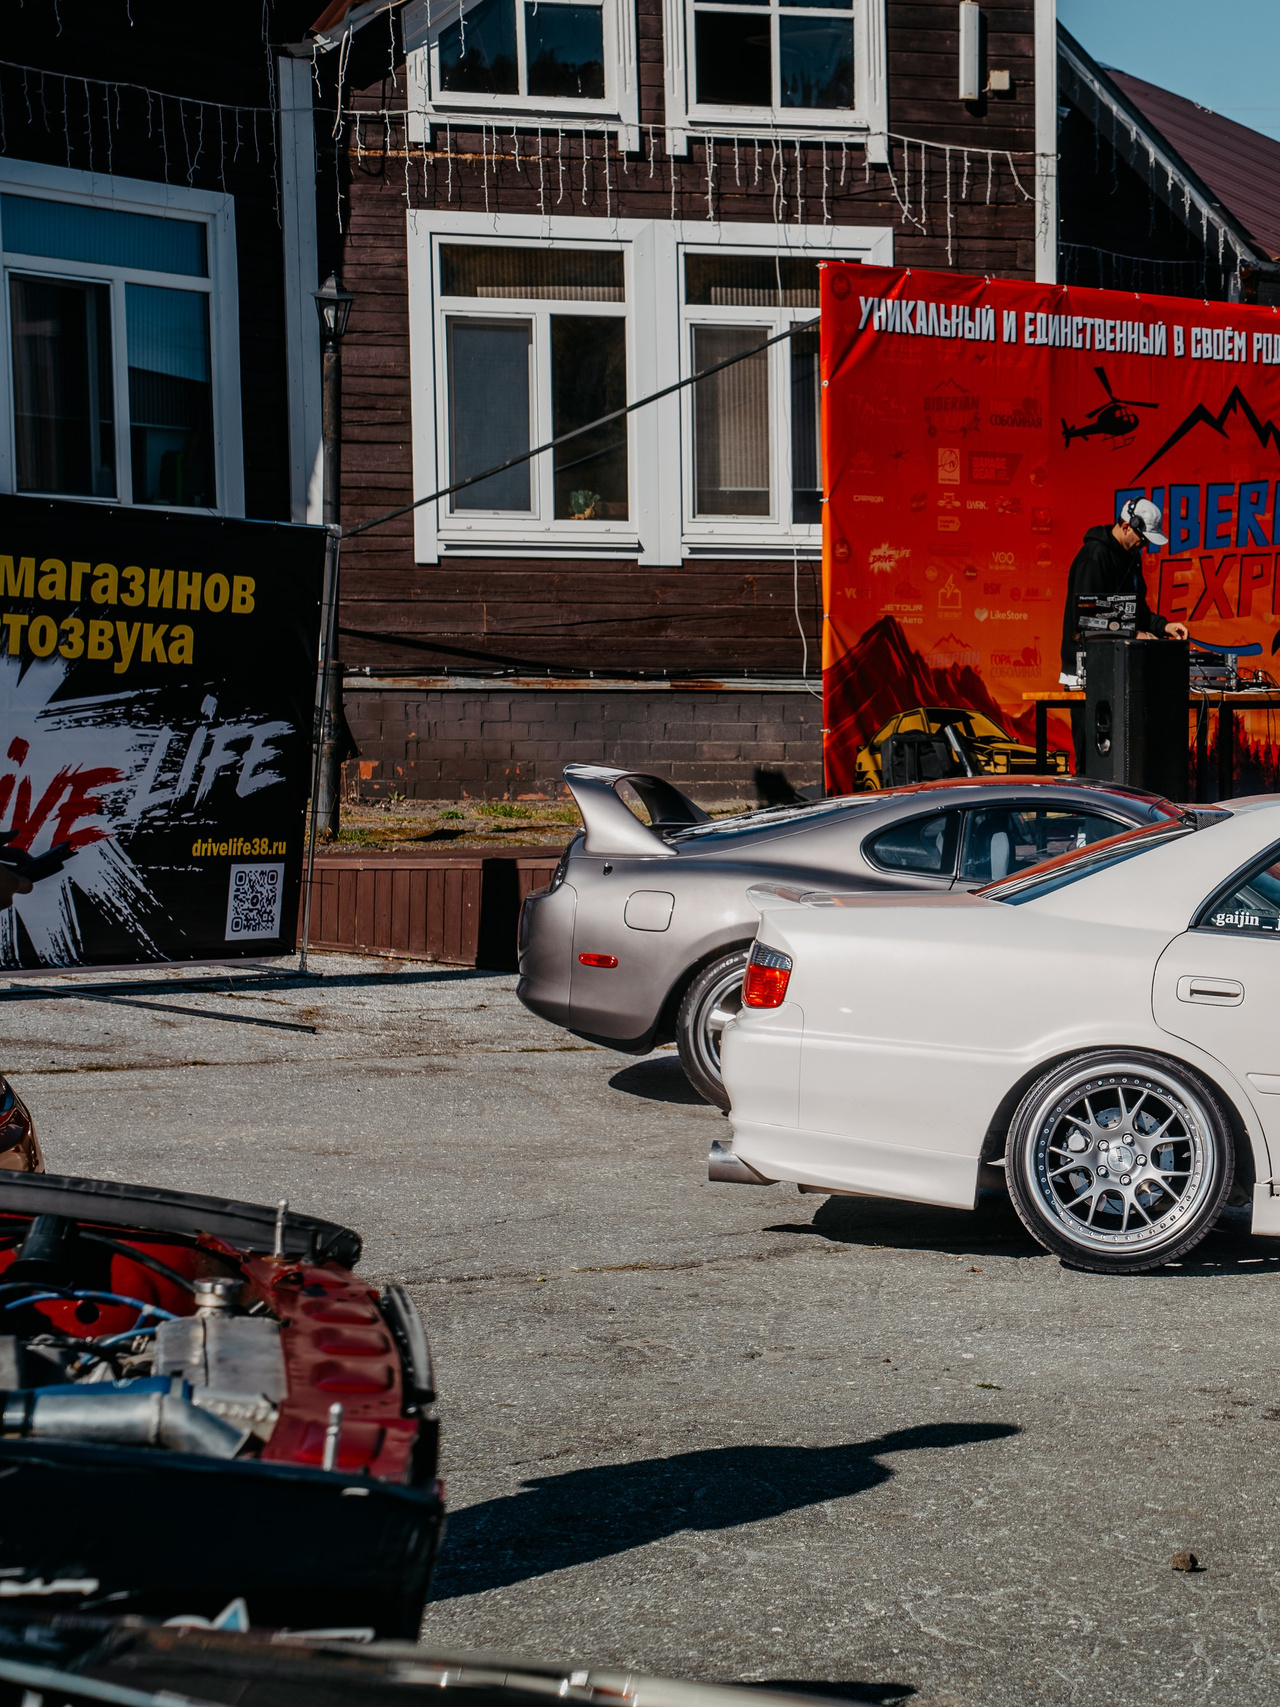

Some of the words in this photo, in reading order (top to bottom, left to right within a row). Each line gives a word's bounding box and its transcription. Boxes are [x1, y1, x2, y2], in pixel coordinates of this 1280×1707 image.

[858, 296, 995, 341] УНИКАЛЬНЫЙ
[1003, 310, 1017, 343] И
[1024, 311, 1167, 356] ЕДИНСТВЕННЫЙ
[1173, 325, 1185, 357] В
[1190, 326, 1247, 362] СВОЁМ
[0, 555, 257, 614] магазинов
[989, 609, 1029, 621] LikeStore
[0, 613, 194, 674] тозвука
[990, 653, 1012, 666] ГОРА
[990, 666, 1042, 679] СОБОЛИНАЯ
[191, 837, 287, 857] drivelife38.ru
[1215, 910, 1260, 928] gaijin
